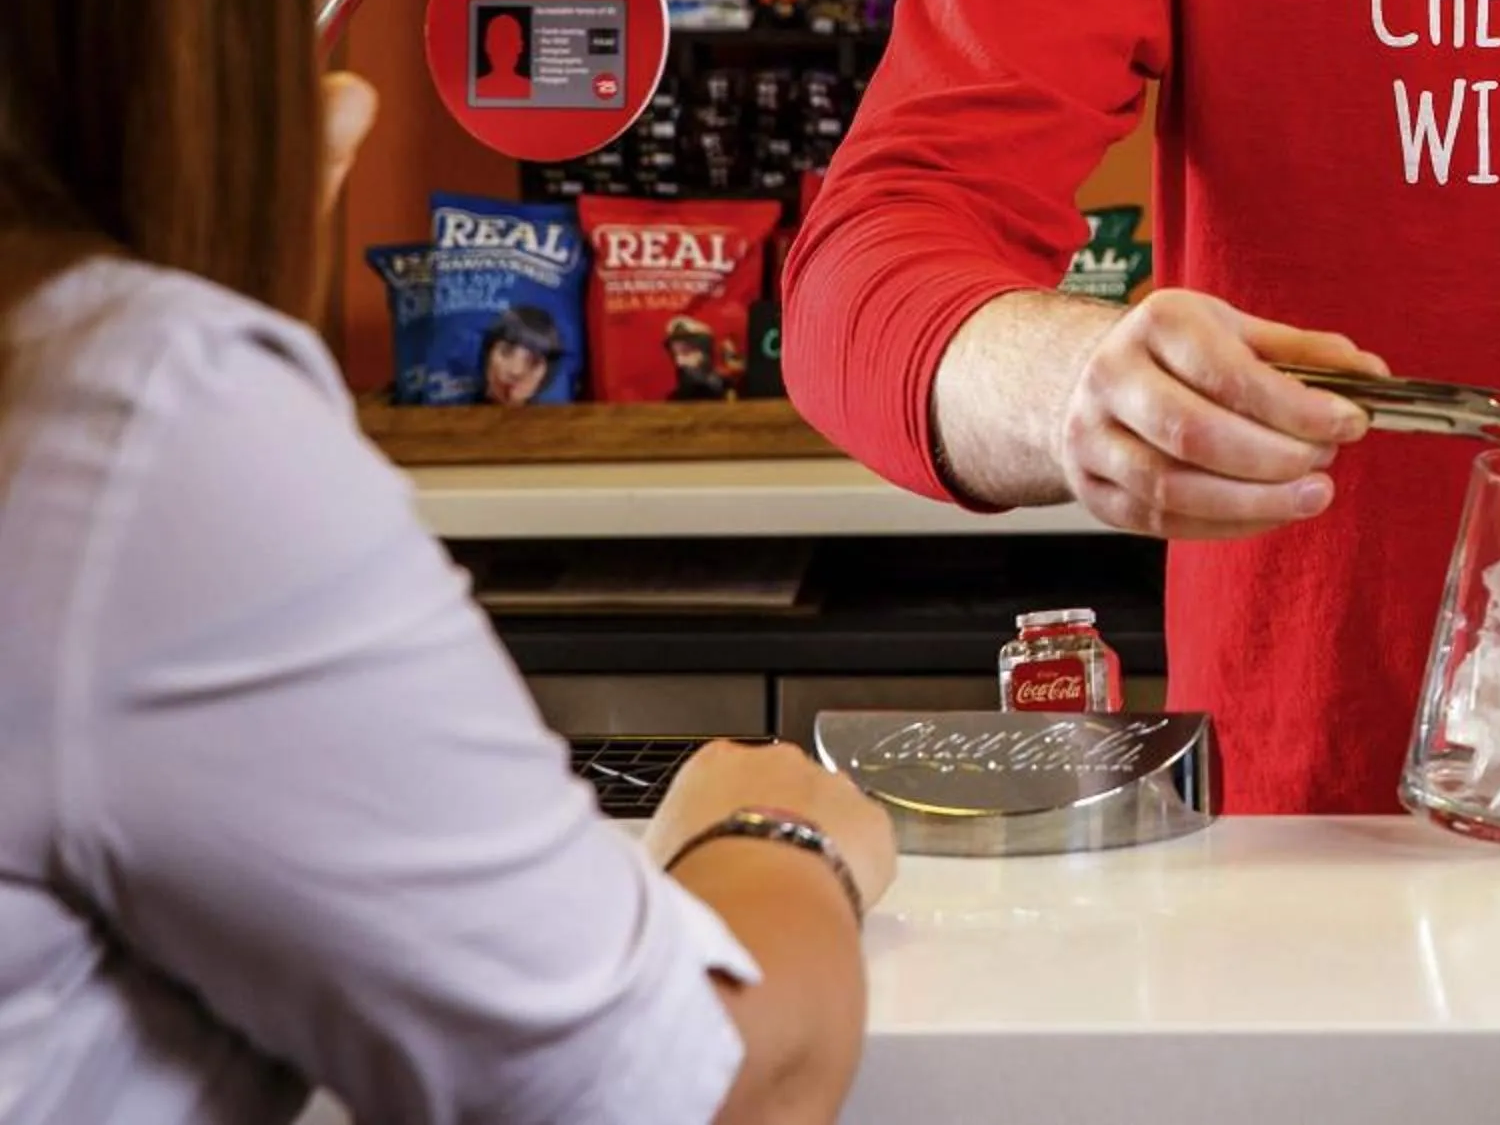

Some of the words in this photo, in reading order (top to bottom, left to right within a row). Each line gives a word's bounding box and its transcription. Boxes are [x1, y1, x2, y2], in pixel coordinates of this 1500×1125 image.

[441, 213, 568, 263] REAL
[605, 229, 736, 274] REAL
[1069, 247, 1128, 271] AL
[1016, 676, 1082, 703] Coca-Cola
